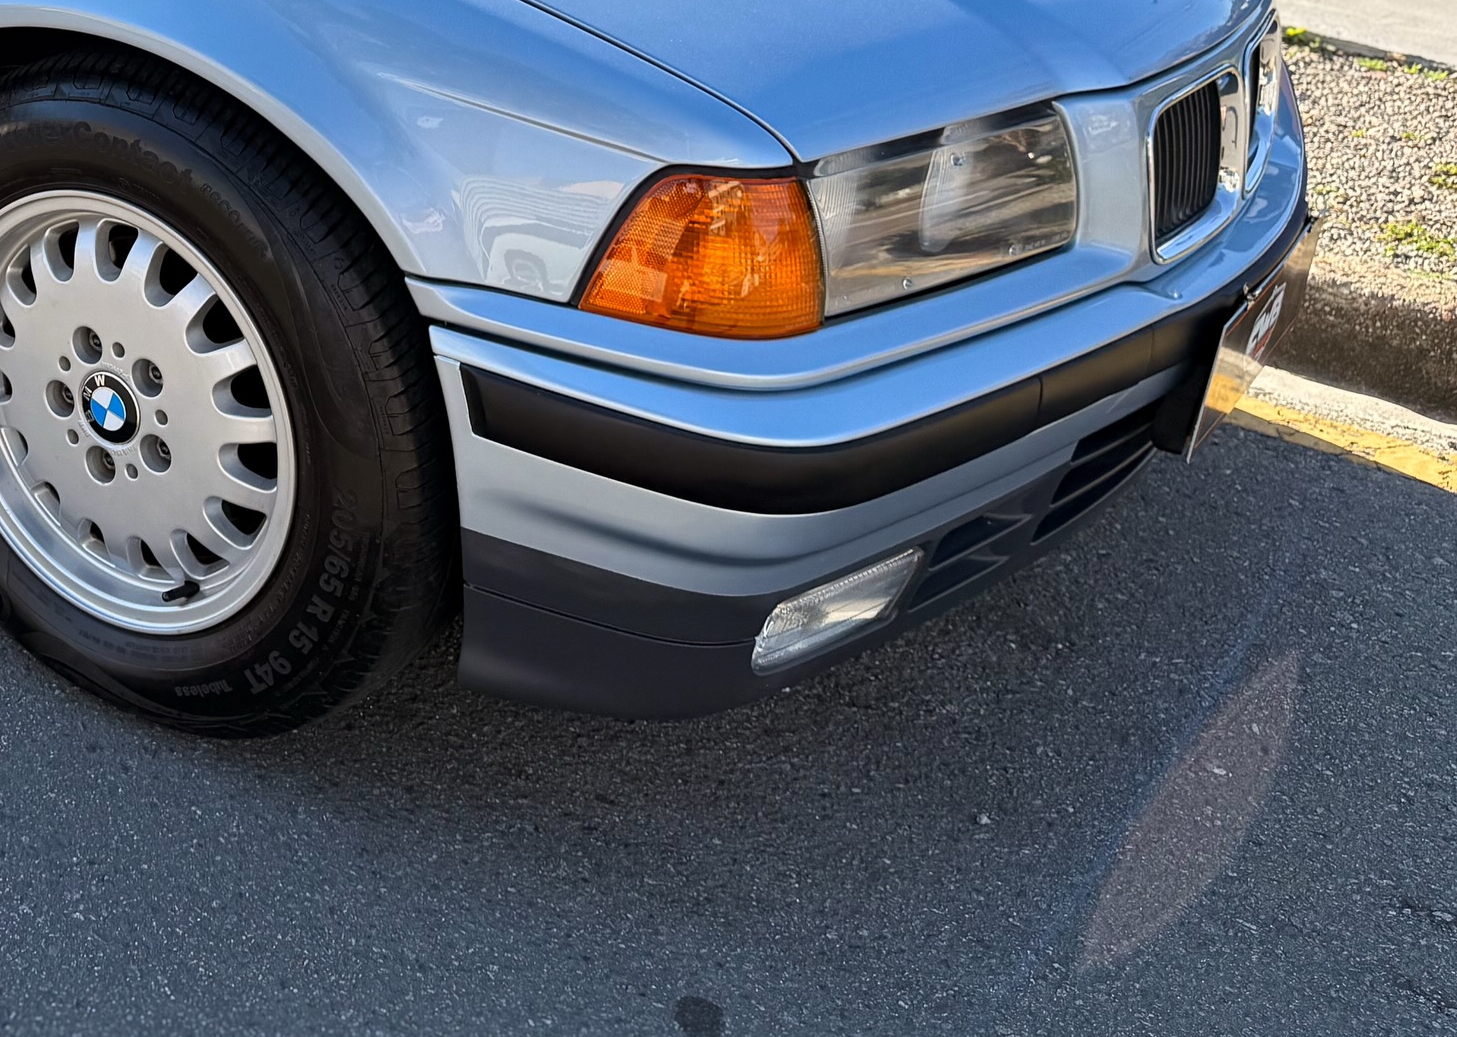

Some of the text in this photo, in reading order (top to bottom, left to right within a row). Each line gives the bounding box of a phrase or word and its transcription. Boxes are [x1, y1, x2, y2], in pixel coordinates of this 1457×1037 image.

[319, 486, 356, 599] 205/65
[305, 593, 336, 622] R
[288, 621, 320, 654] 15
[174, 678, 233, 699] Tubeless
[243, 649, 292, 695] 94T
